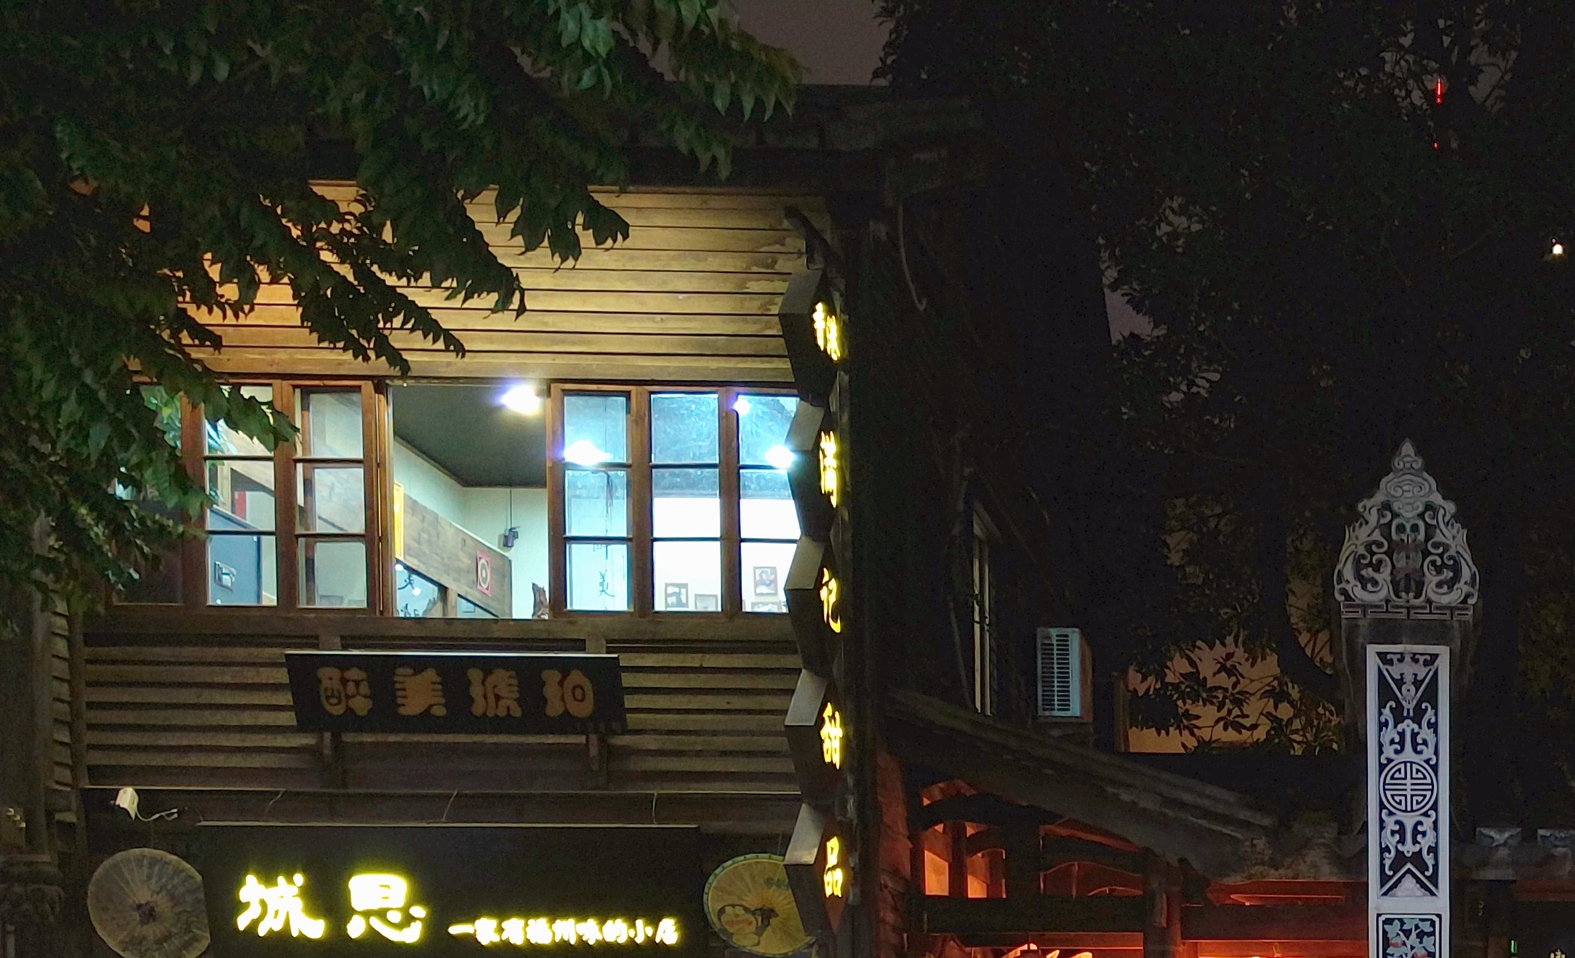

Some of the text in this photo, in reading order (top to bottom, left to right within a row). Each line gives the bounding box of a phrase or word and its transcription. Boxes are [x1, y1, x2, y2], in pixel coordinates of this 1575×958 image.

[448, 917, 679, 946] 一家有福州味的小店
